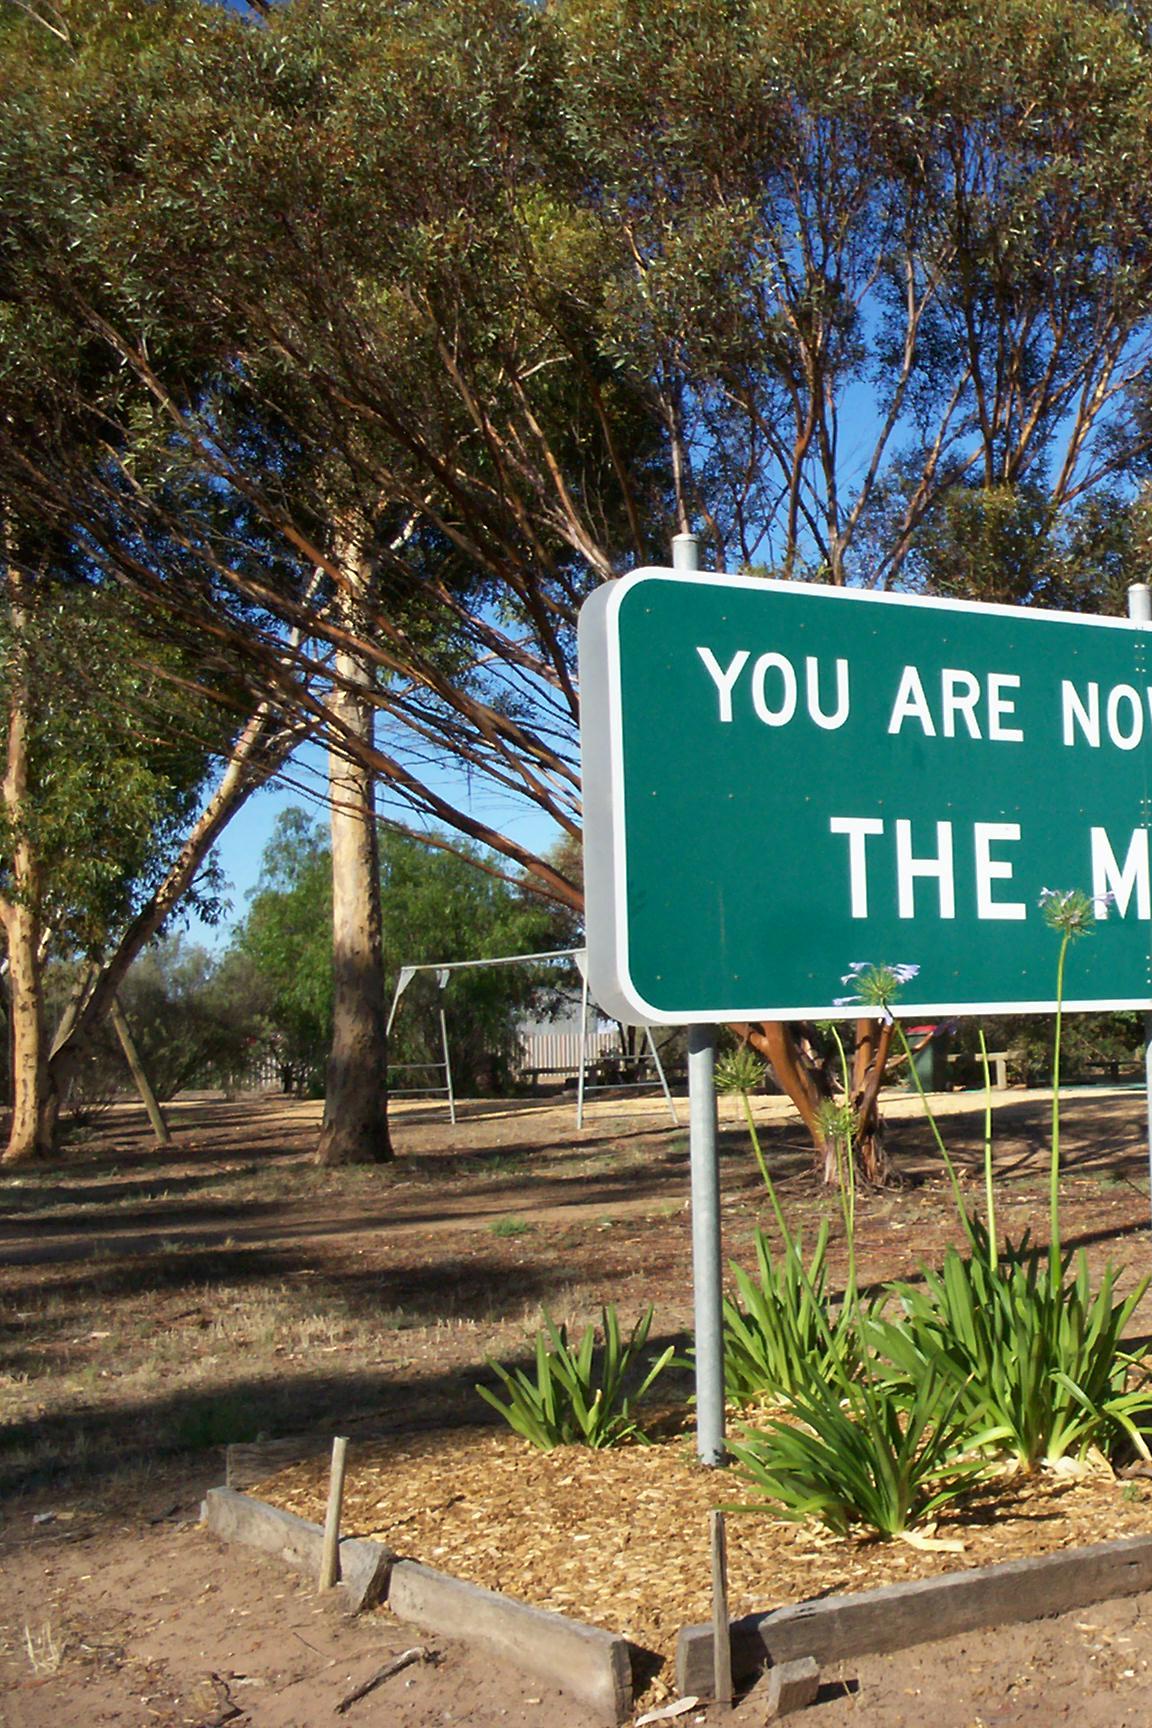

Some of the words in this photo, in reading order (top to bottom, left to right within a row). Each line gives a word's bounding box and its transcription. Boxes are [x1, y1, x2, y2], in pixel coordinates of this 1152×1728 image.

[696, 646, 850, 730] YOU
[887, 665, 1024, 742] ARE
[829, 816, 1027, 920] THE
